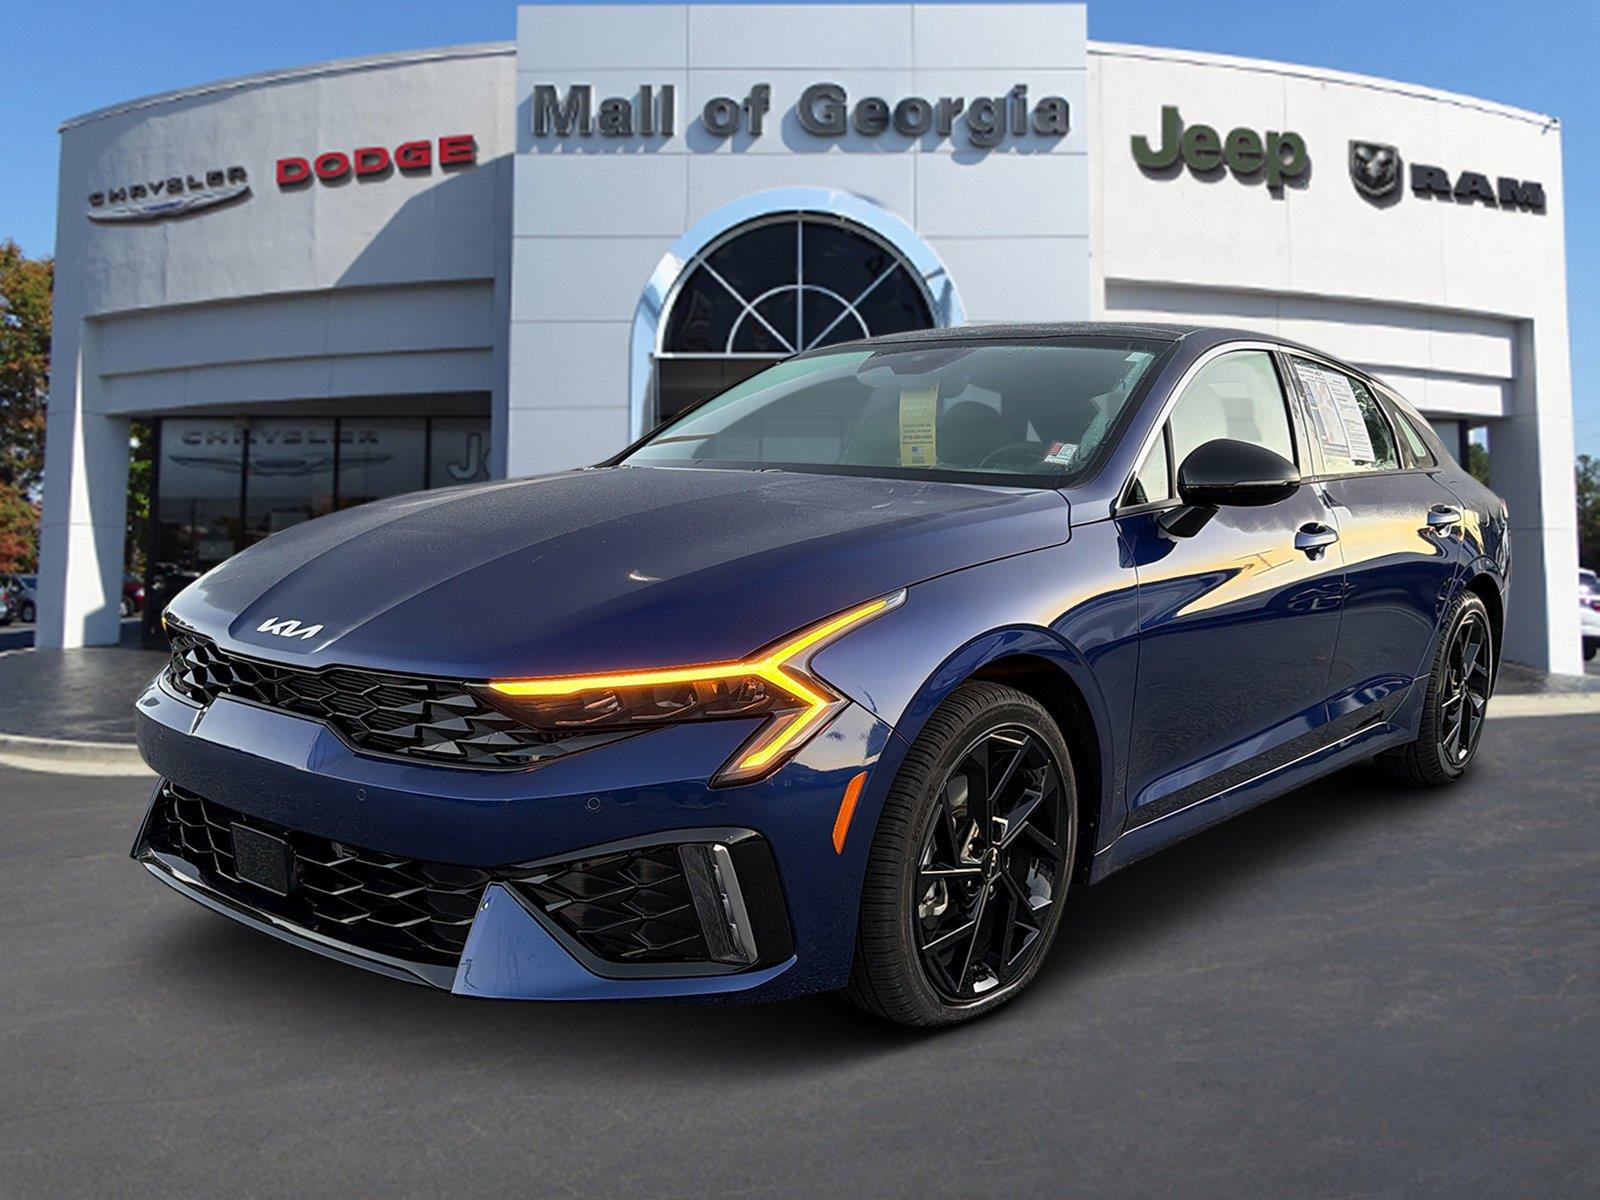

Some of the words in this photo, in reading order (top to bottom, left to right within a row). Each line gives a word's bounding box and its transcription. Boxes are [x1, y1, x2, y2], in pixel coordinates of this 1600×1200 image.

[533, 84, 675, 137] Mall
[703, 83, 771, 137] of
[799, 82, 1070, 149] Georgia
[276, 134, 475, 186] DODGE
[1131, 105, 1308, 189] Jeep
[88, 166, 248, 207] CHRYSLER
[1409, 163, 1543, 208] RAM
[181, 430, 380, 445] CHRYSLER
[447, 432, 491, 480] J
[256, 617, 324, 640] KIA
